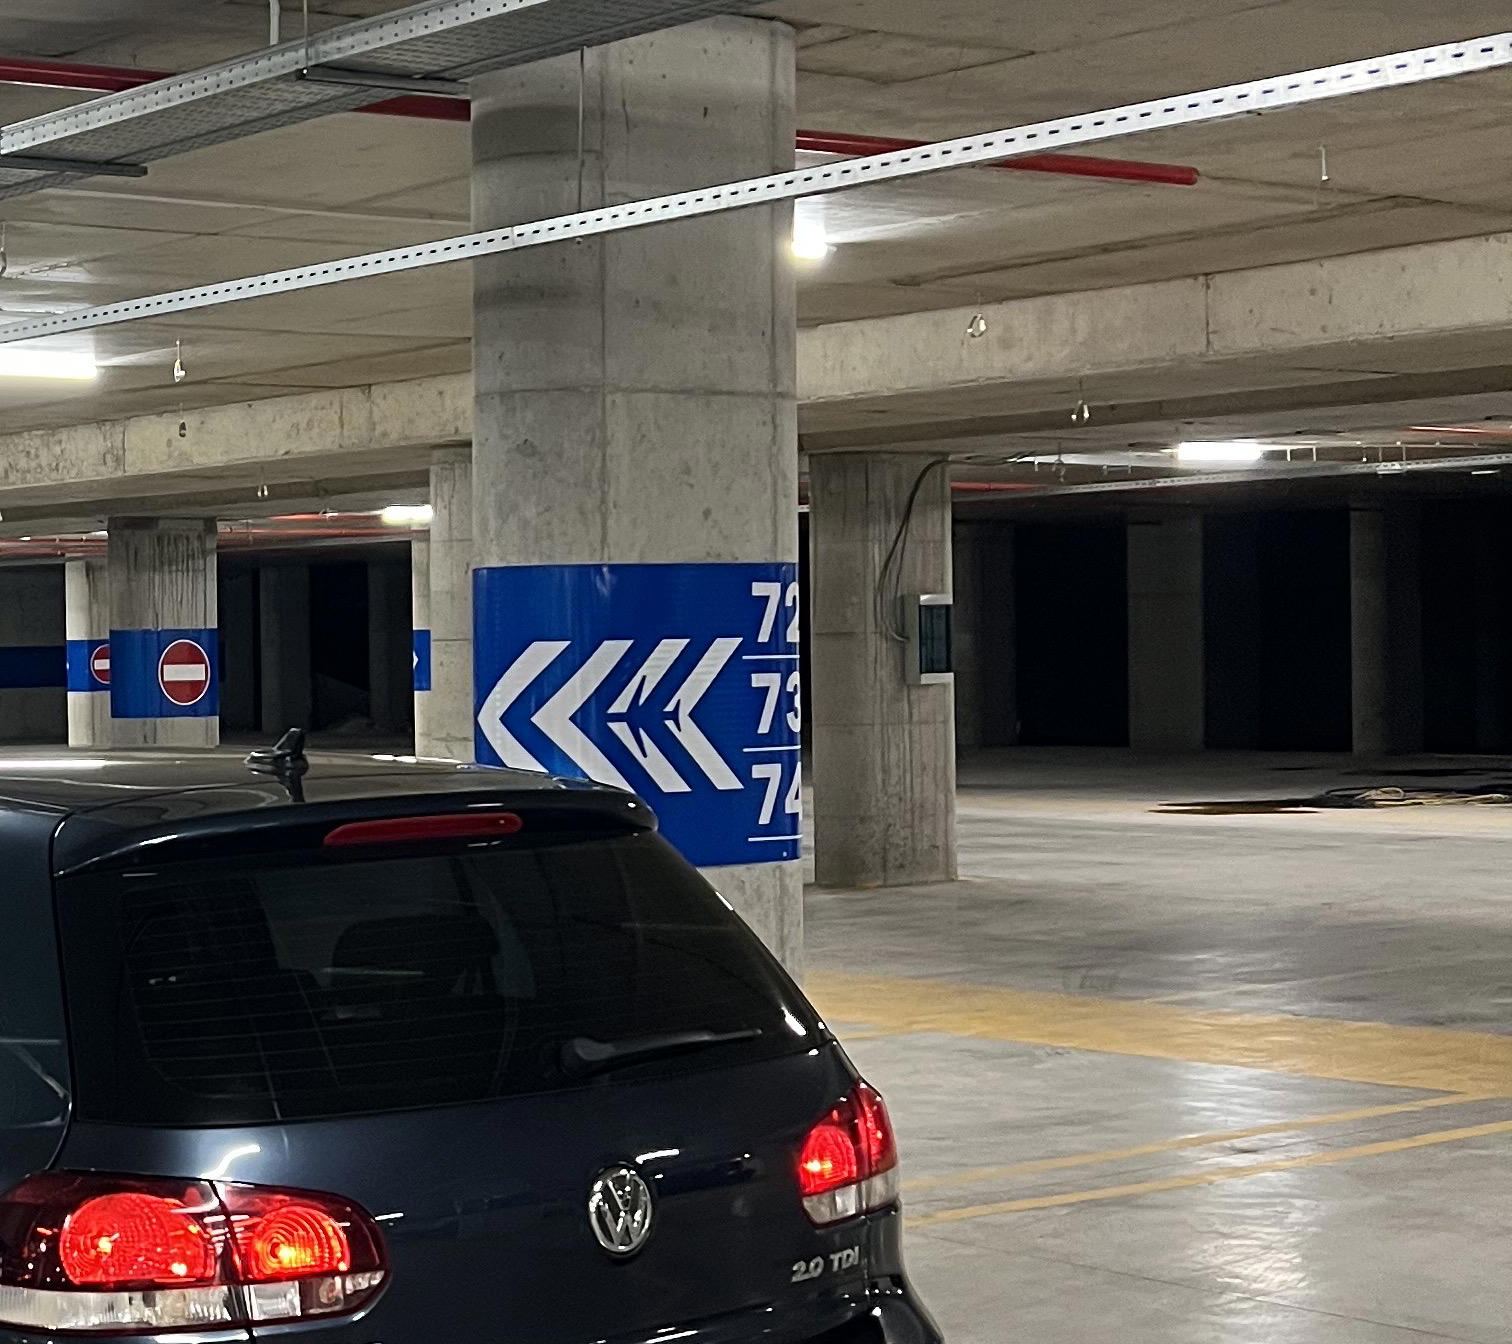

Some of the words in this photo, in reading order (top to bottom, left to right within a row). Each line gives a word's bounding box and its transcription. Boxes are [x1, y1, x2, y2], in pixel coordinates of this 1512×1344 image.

[751, 581, 800, 643] 72
[751, 671, 801, 734] 73
[751, 761, 802, 825] 74
[589, 1167, 652, 1252] VW
[829, 1245, 859, 1272] TDI
